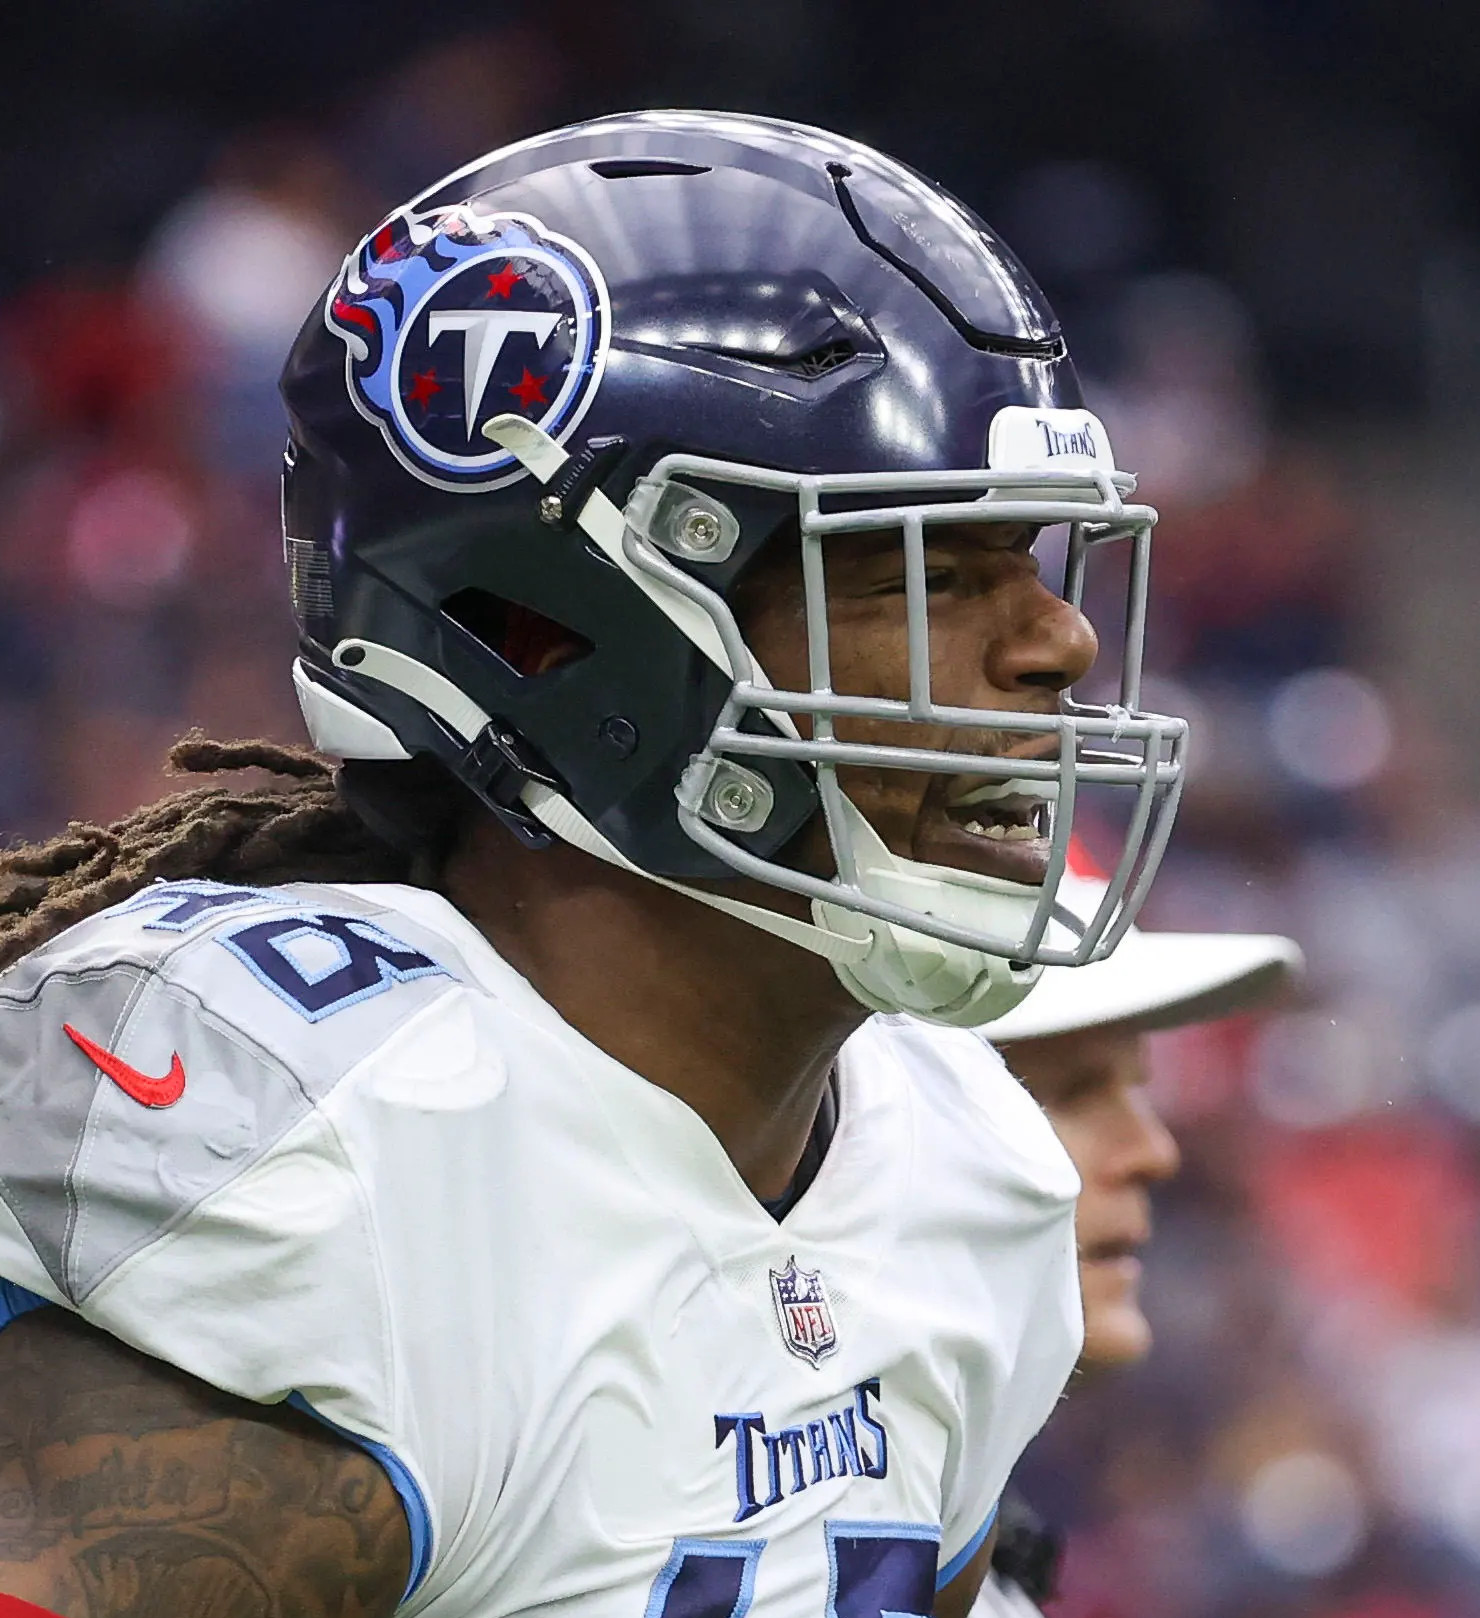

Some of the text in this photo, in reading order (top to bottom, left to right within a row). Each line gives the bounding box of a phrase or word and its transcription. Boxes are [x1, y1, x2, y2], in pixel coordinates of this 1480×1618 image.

[1036, 419, 1097, 459] TITANS
[789, 1304, 831, 1342] NFL
[714, 1376, 887, 1523] TITANS
